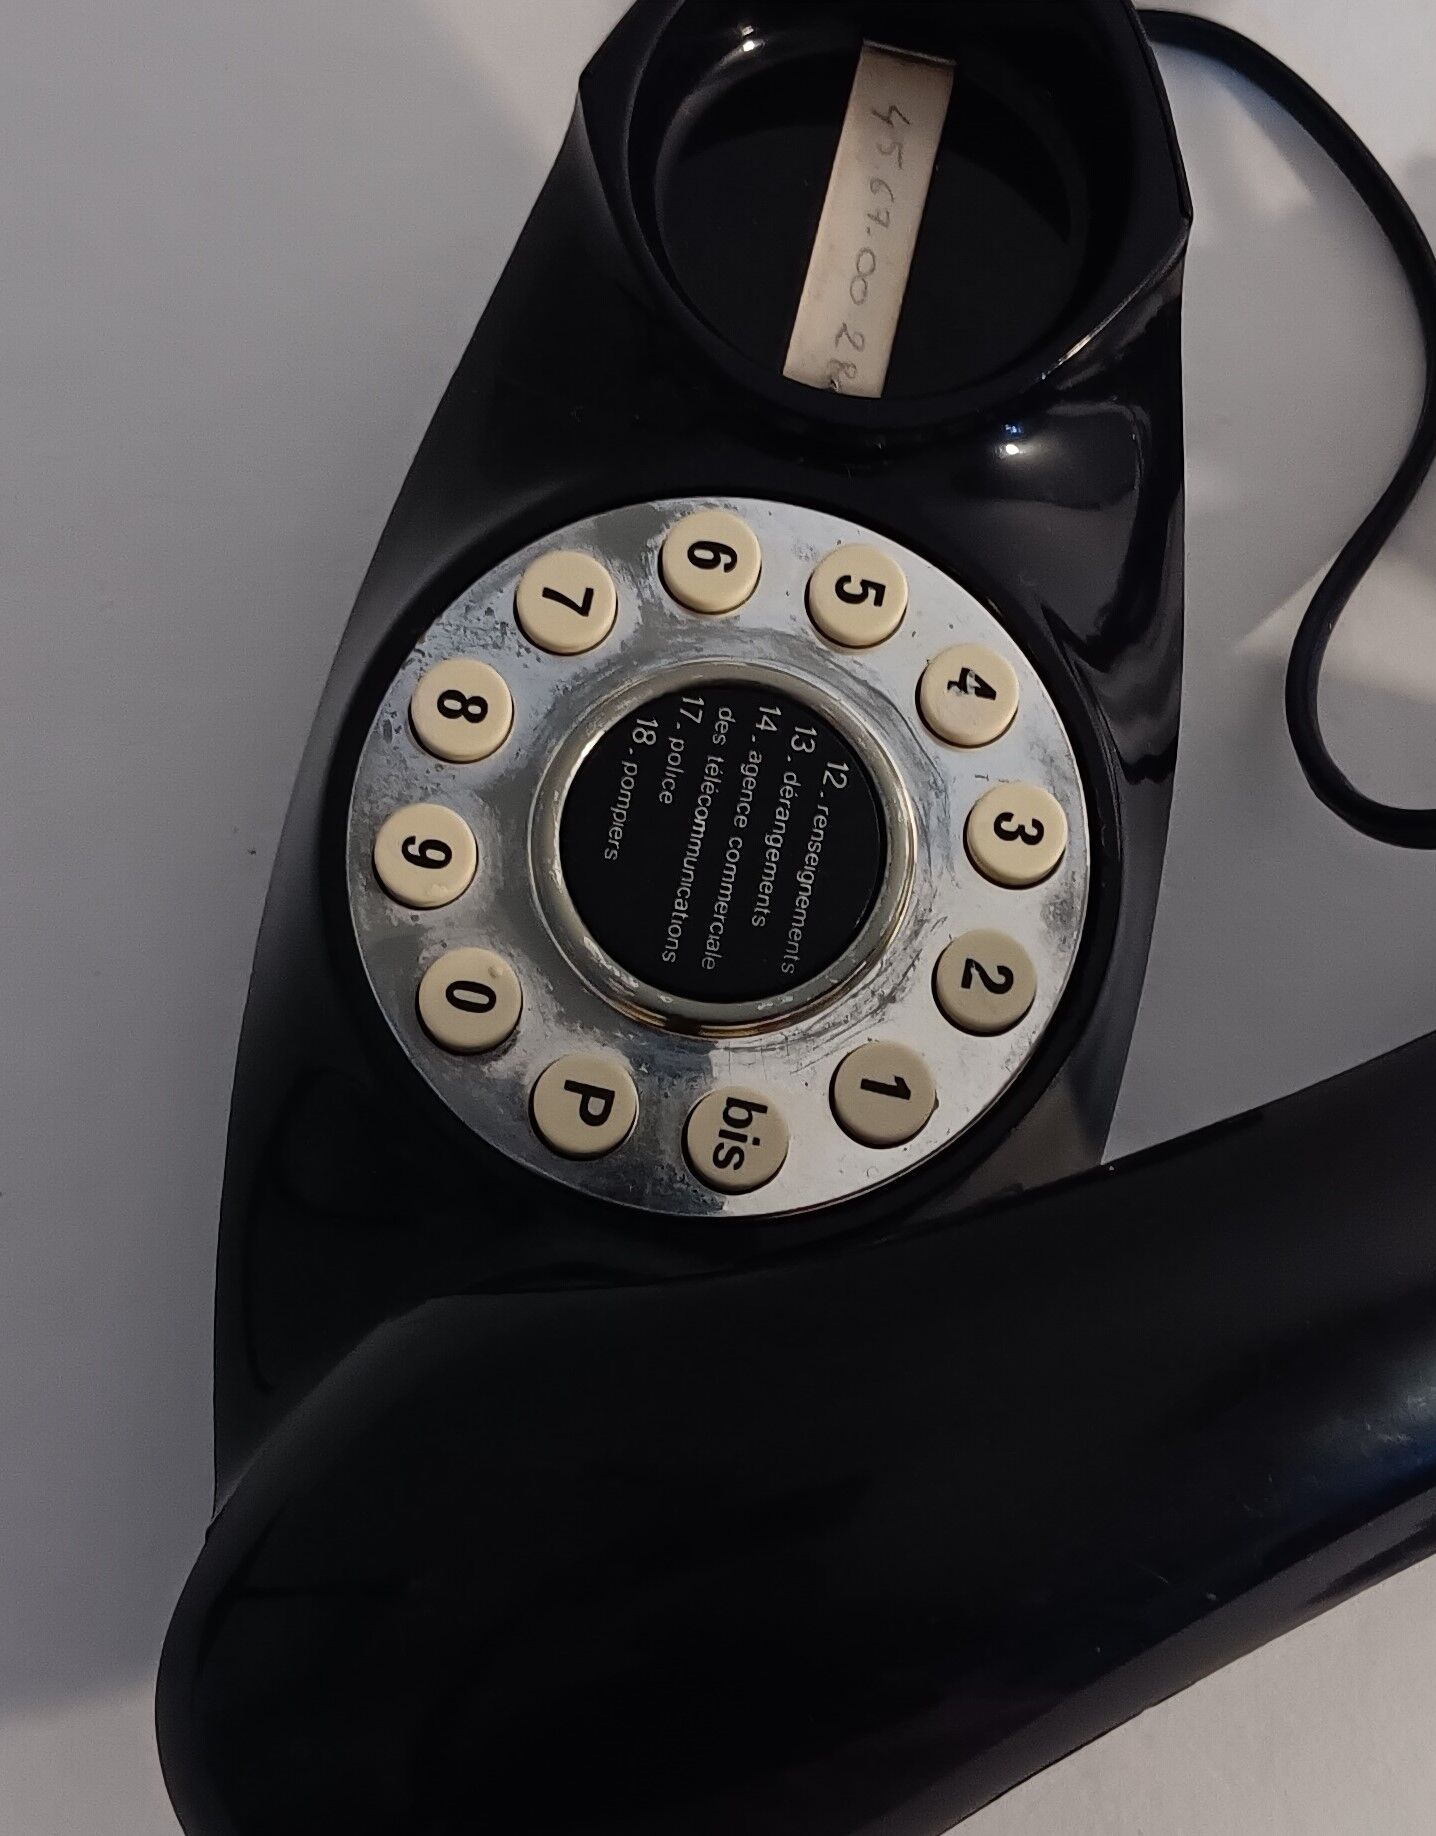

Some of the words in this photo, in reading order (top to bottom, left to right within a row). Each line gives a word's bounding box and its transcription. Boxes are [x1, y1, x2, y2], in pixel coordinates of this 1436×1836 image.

[687, 540, 738, 573] 6
[541, 587, 594, 617] 7
[834, 574, 886, 607] 5
[946, 667, 997, 701] 4
[436, 689, 489, 724] 8
[712, 707, 736, 746] des
[658, 736, 685, 805] police
[733, 750, 763, 828] agence
[604, 760, 638, 861] pompiers
[993, 811, 1045, 846] 3
[401, 835, 453, 870] 9
[661, 755, 725, 963] télécommunications
[751, 771, 802, 927] dérangements
[701, 836, 743, 970] commerciale
[781, 804, 829, 974] renseignements
[960, 957, 1014, 995] 2
[445, 980, 497, 1014] 0
[563, 1079, 616, 1127] P
[859, 1075, 912, 1101] 1
[712, 1096, 768, 1171] bis
